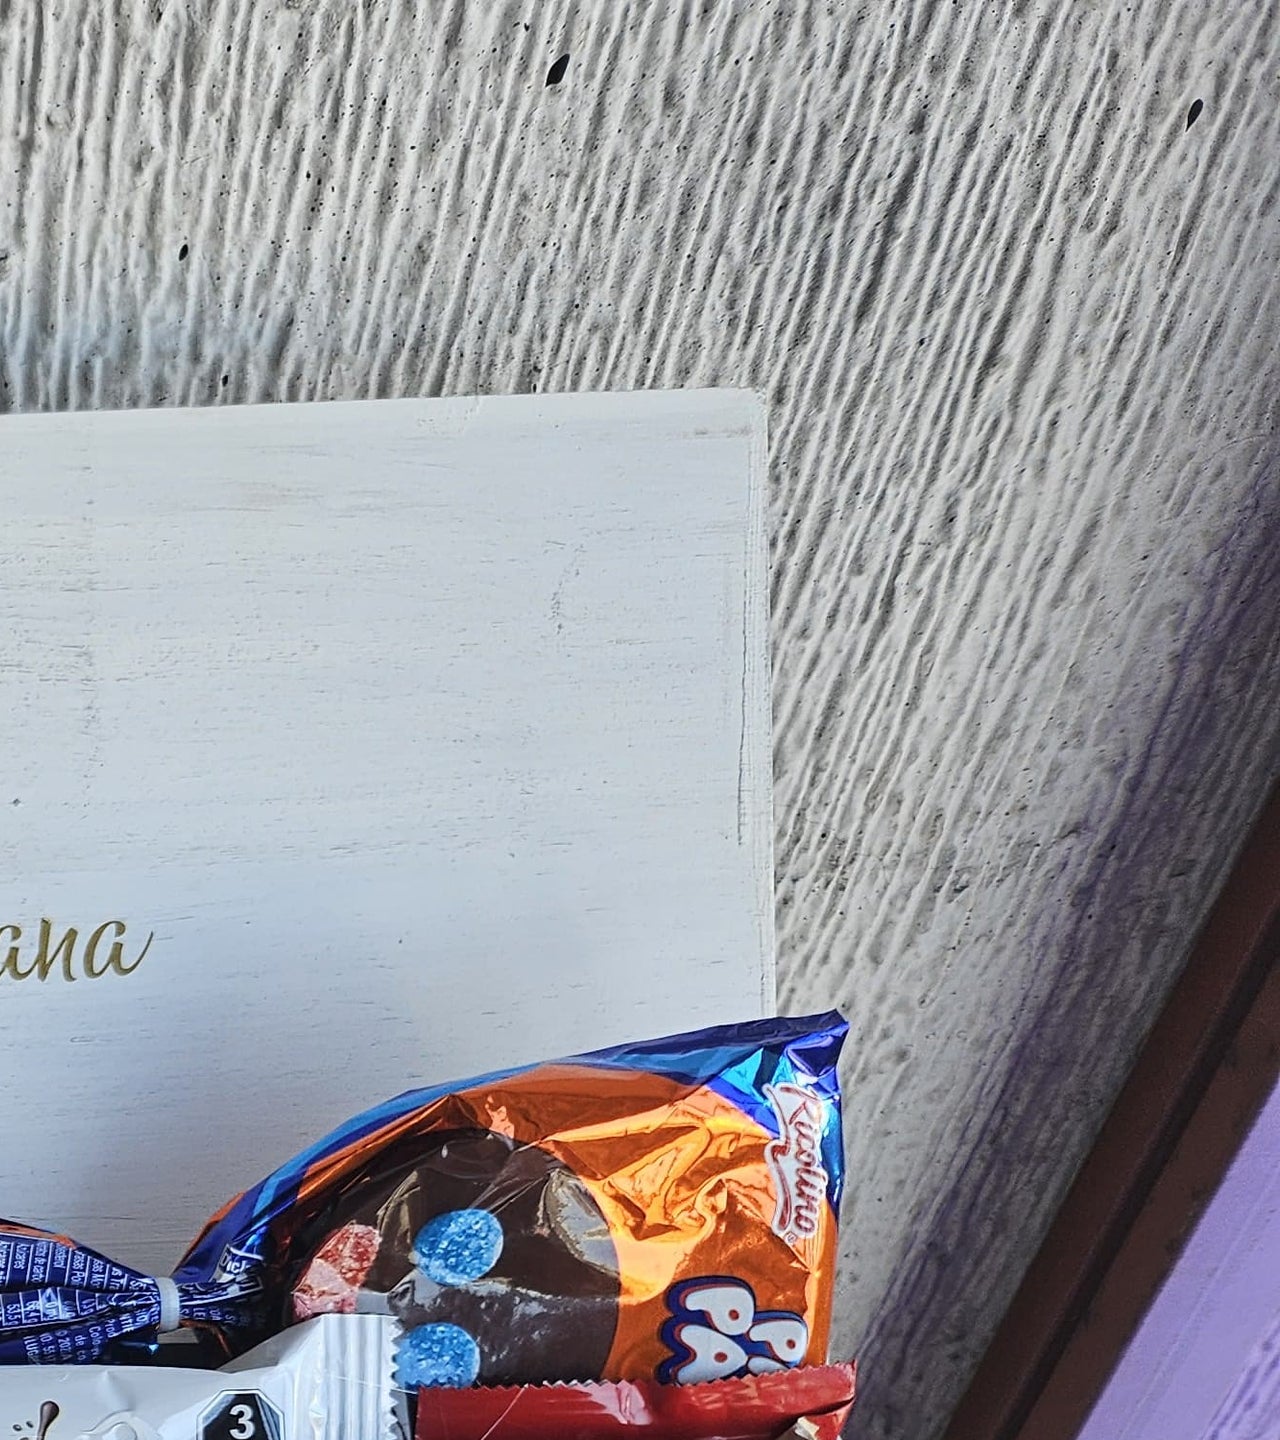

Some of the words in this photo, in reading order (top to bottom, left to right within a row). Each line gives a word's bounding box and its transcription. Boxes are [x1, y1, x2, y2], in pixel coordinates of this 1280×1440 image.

[766, 1085, 827, 1233] Ricolino
[6, 1304, 20, 1320] 53,5
[229, 1404, 256, 1440] 3
